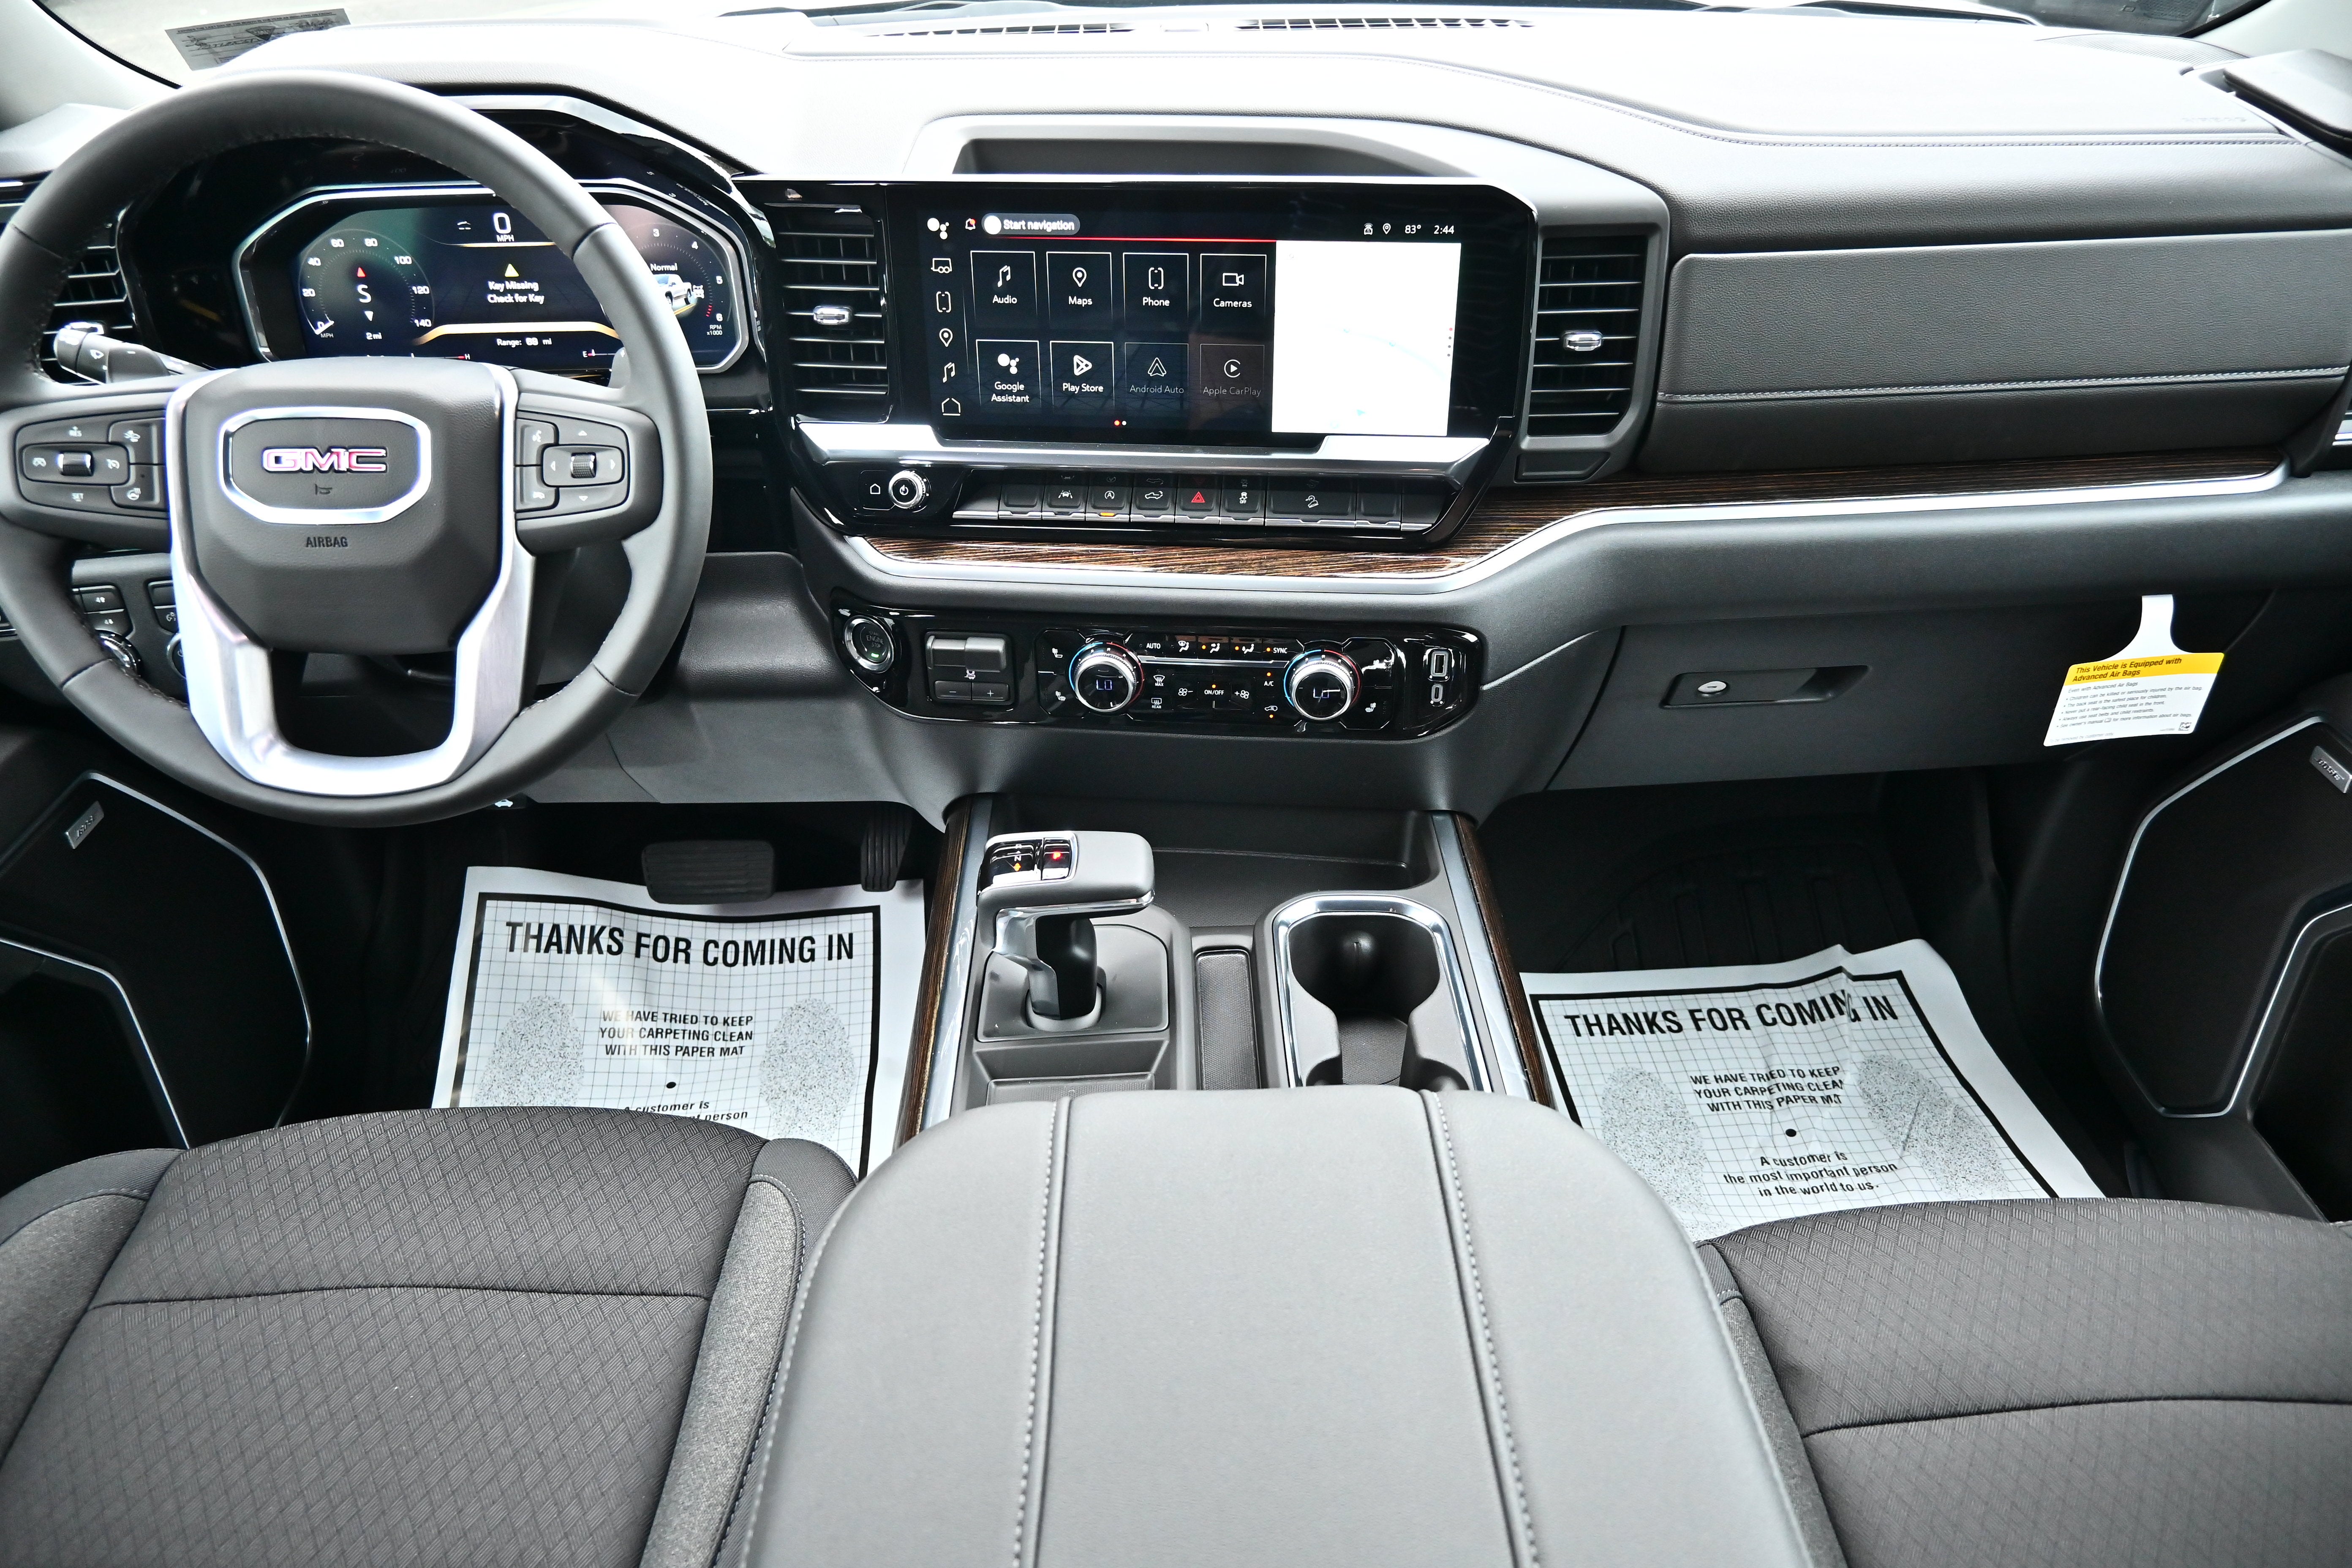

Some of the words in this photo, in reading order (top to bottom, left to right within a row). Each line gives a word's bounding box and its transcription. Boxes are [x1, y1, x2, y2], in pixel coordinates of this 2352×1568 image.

[493, 212, 512, 234] 0
[1003, 219, 1026, 230] Start
[1027, 220, 1075, 232] navigation
[653, 229, 659, 237] 3
[1405, 225, 1421, 234] 83°
[1434, 225, 1454, 234] 2:44
[331, 239, 344, 247] 60
[365, 238, 378, 247] 80
[691, 241, 698, 250] 4
[308, 258, 321, 266] 40
[394, 256, 412, 264] 100
[650, 263, 678, 271] Normal
[716, 275, 723, 284] 5
[412, 286, 429, 294] 120
[488, 281, 505, 292] Key
[506, 281, 539, 291] Missing
[302, 289, 316, 297] 20
[357, 284, 371, 303] S
[487, 294, 514, 303] Check
[514, 294, 528, 302] for
[528, 294, 544, 304] Key
[992, 295, 1017, 304] Audio
[1068, 296, 1092, 307] Maps
[1143, 297, 1170, 306] Phone
[1213, 298, 1252, 308] Cameras
[716, 313, 723, 321] 6
[497, 338, 522, 348] Range:
[994, 381, 1025, 395] Google
[1062, 383, 1080, 394] Play
[1081, 383, 1104, 392] Store
[1130, 385, 1162, 394] Android
[1164, 385, 1184, 394] Auto
[1203, 386, 1227, 397] Apple
[1229, 387, 1261, 397] CarPlay
[991, 394, 1029, 403] Assistant
[262, 448, 387, 472] GMC
[305, 536, 348, 548] AIRBAG
[2093, 663, 2119, 672] Vehicle
[2129, 659, 2164, 668] Equipped
[2072, 672, 2108, 682] Advanced
[506, 922, 623, 956] THANKS
[634, 933, 691, 964] FOR
[703, 936, 816, 967] COMING
[827, 933, 854, 960] IN
[603, 1011, 621, 1021] WE
[628, 1011, 658, 1022] HAVE
[662, 1013, 698, 1024] TRIED
[703, 1015, 718, 1026] TO
[723, 1016, 753, 1026] KEEP
[1565, 1010, 1683, 1037] THANKS
[1690, 1008, 1751, 1032] FOR
[1756, 990, 1860, 1026] COMING
[1862, 996, 1899, 1020] IN
[599, 1027, 634, 1039] YOUR
[639, 1028, 709, 1041] CARPETING
[714, 1030, 753, 1042] CLEAN
[605, 1044, 637, 1056] WITH
[642, 1045, 670, 1056] THIS
[675, 1045, 714, 1057] PAPER
[720, 1045, 745, 1056] MAT
[1690, 1075, 1711, 1085] WE
[1714, 1073, 1748, 1084] HAVE
[1749, 1069, 1786, 1083] TRIED
[1788, 1069, 1806, 1079] TO
[1809, 1066, 1840, 1078] KEEP
[1695, 1088, 1731, 1098] YOUR
[1734, 1082, 1805, 1097] CARPETING
[635, 1102, 695, 1113] customer
[699, 1101, 709, 1109] is
[1707, 1102, 1742, 1112] WITH
[1746, 1100, 1773, 1111] THIS
[1776, 1095, 1817, 1107] PAPER
[705, 1112, 748, 1121] person
[1760, 1156, 1771, 1167] A
[1772, 1153, 1831, 1167] customer
[1835, 1151, 1848, 1162] is
[1723, 1174, 1745, 1184] the
[1749, 1171, 1783, 1183] most
[1786, 1166, 1850, 1182] important
[1852, 1162, 1898, 1177] person
[1758, 1187, 1772, 1198] in
[1775, 1185, 1797, 1195] the
[1799, 1182, 1838, 1195] world
[1840, 1182, 1854, 1192] to
[1858, 1183, 1880, 1192] us.
